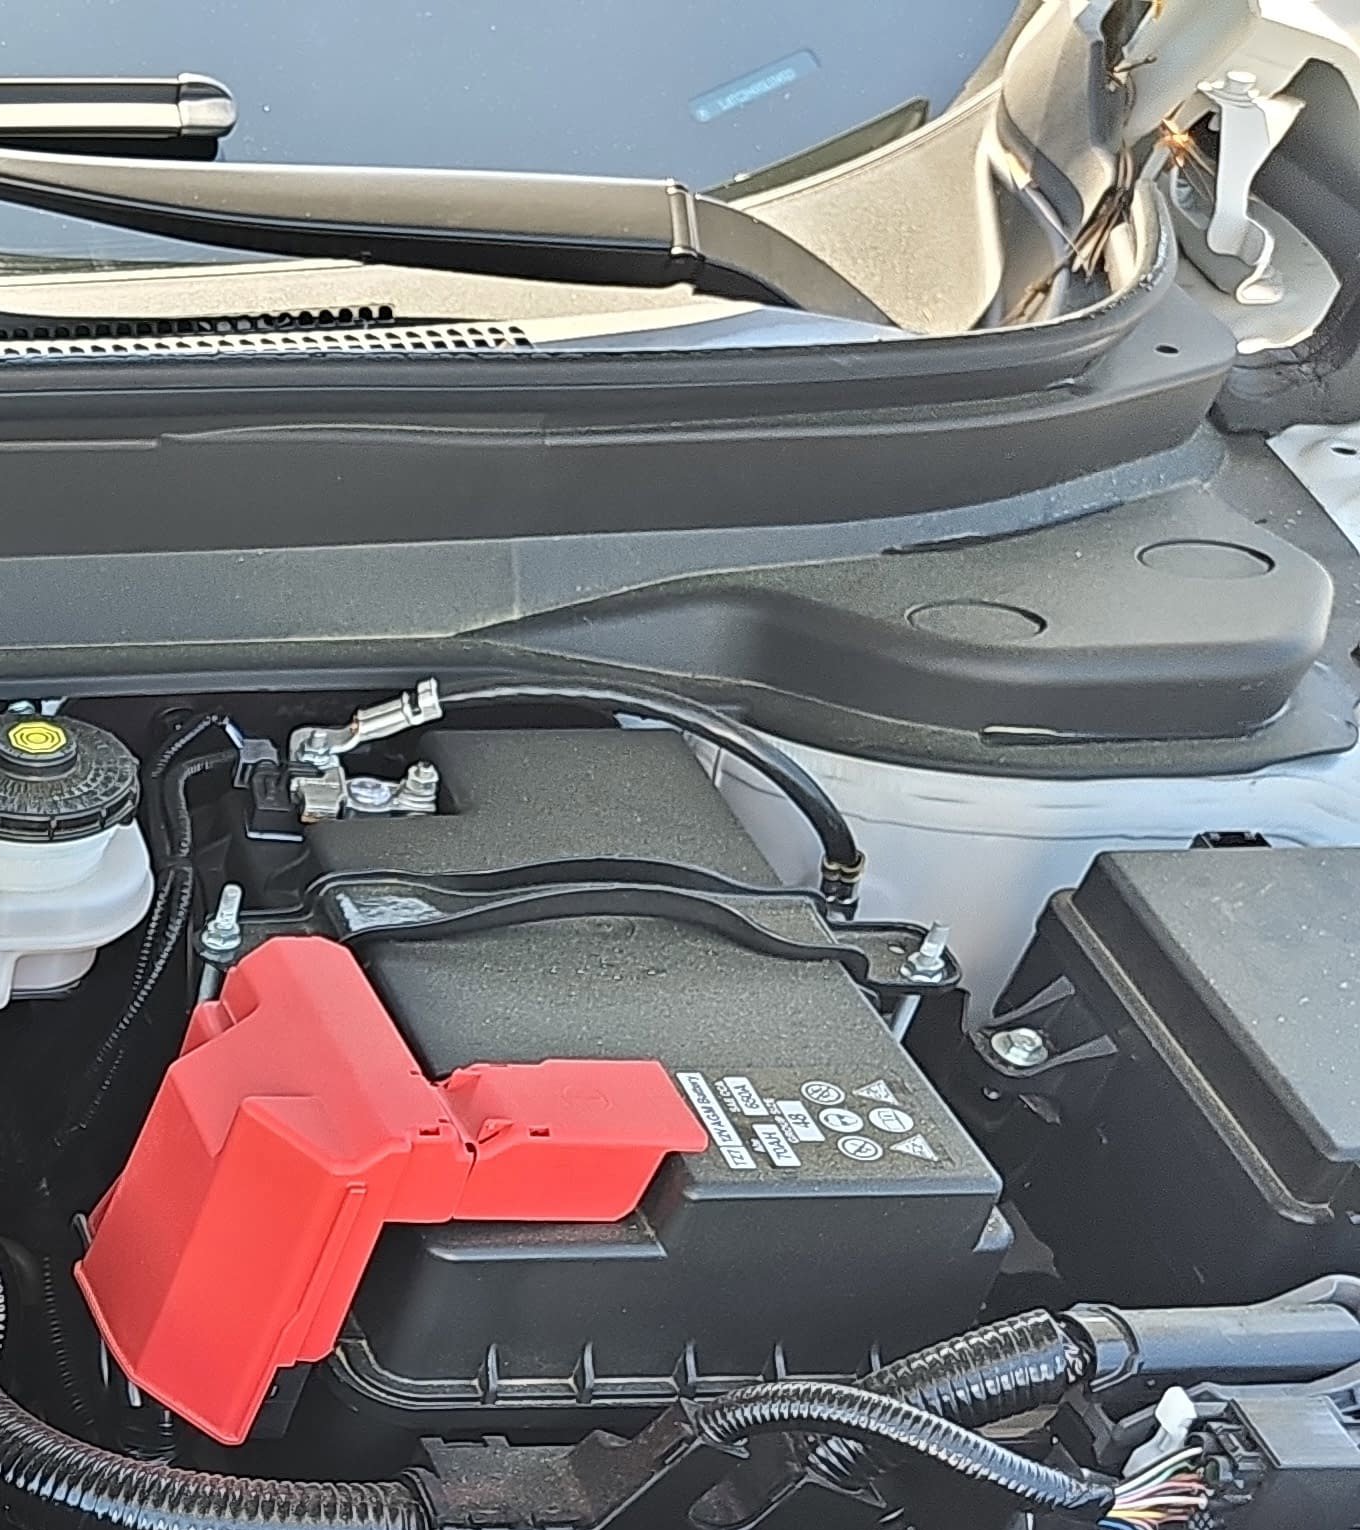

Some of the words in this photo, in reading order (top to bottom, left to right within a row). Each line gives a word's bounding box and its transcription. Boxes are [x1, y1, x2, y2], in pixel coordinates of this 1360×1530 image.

[686, 1076, 712, 1104] Battery
[701, 1106, 725, 1127] AGM
[789, 1113, 812, 1128] 48
